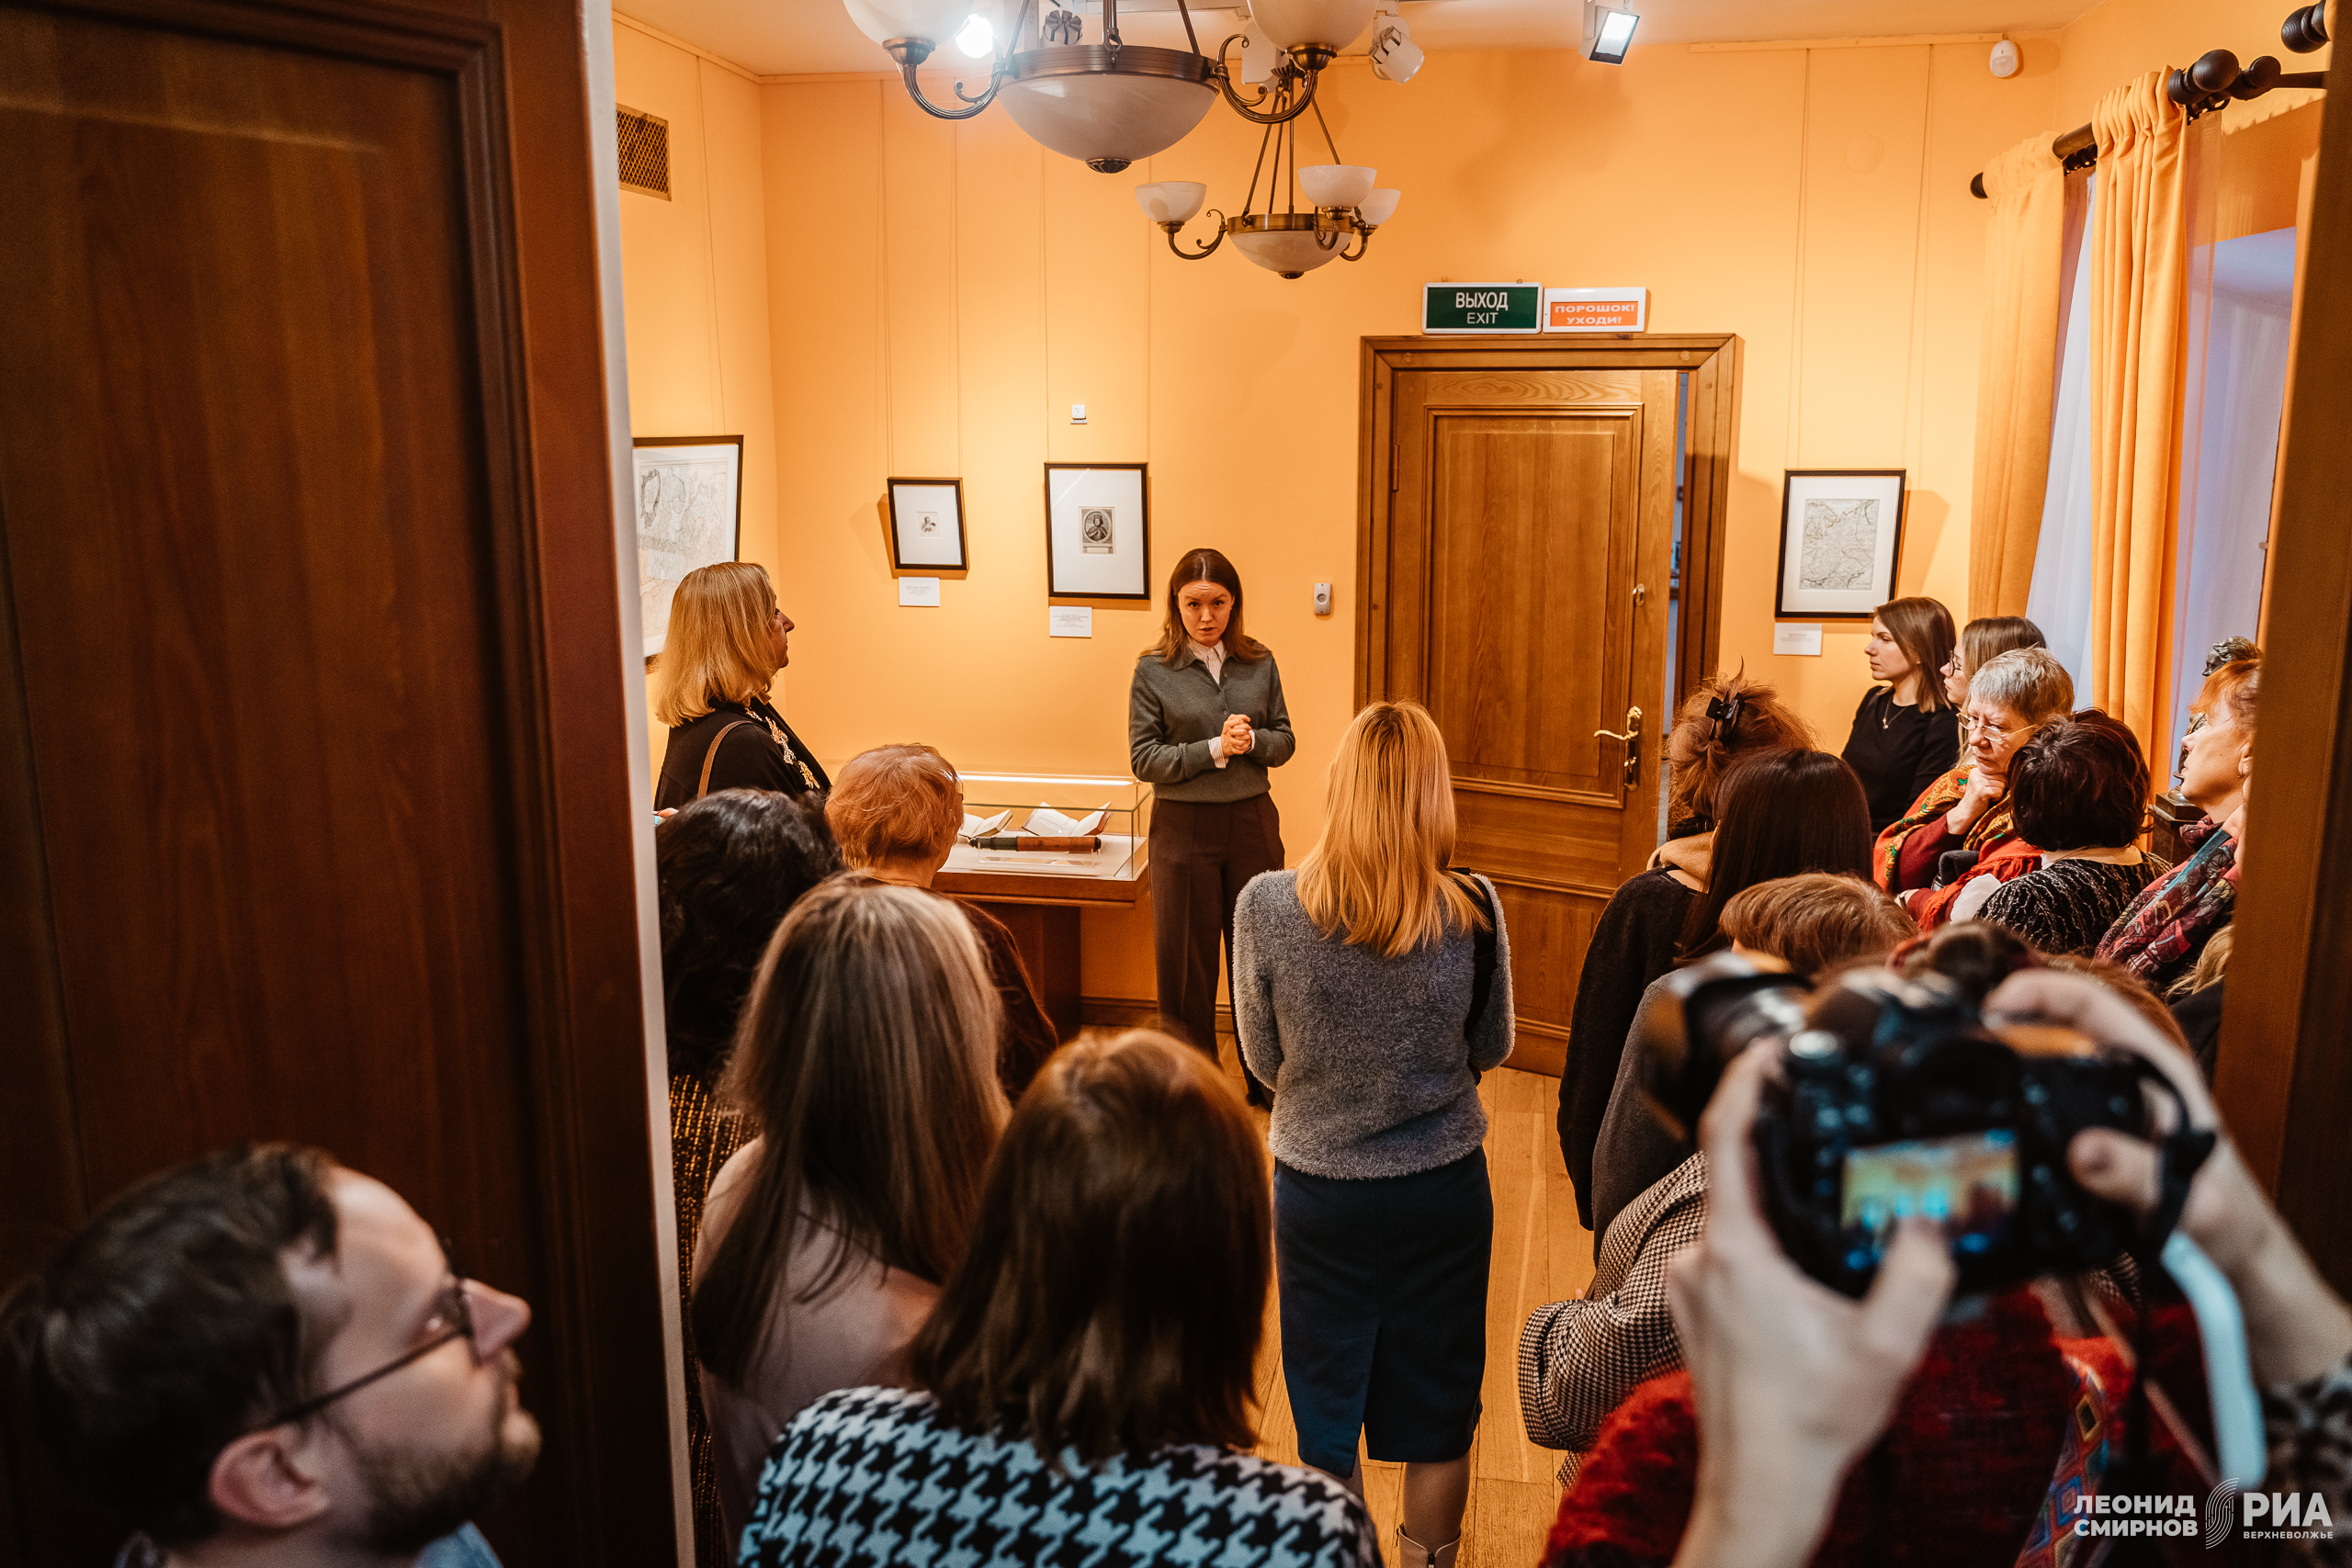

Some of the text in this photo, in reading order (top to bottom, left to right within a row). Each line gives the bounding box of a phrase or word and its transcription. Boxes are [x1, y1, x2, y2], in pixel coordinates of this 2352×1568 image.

[1455, 291, 1509, 311] ВЫХОД
[1555, 304, 1634, 313] ПОРОШОК!
[1466, 312, 1498, 324] EXIT
[1566, 316, 1622, 325] УХОДИ!
